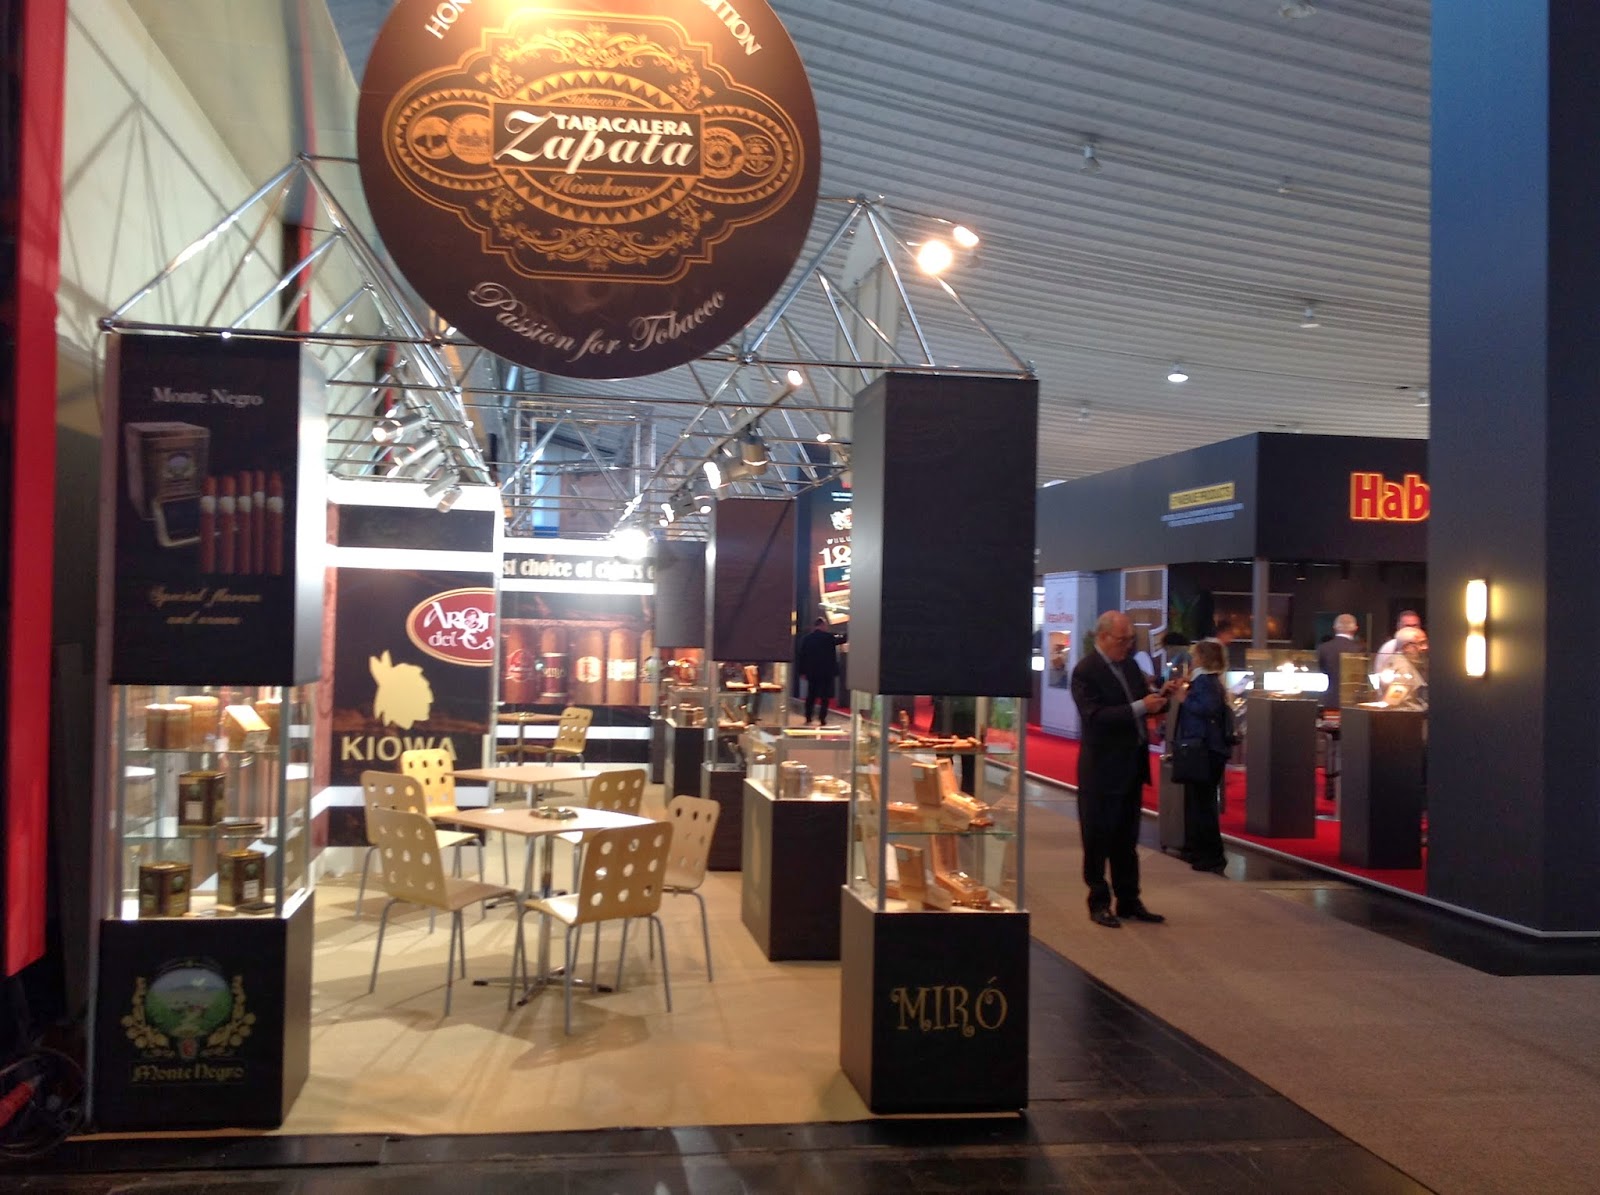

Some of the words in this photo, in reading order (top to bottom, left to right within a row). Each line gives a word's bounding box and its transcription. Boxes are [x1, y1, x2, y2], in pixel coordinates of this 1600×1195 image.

[493, 109, 699, 175] Zapata
[552, 113, 694, 137] TABACALERA
[467, 281, 576, 352] Passion
[565, 328, 622, 364] for
[628, 289, 727, 352] Tobacco
[520, 558, 573, 577] choice
[890, 976, 1009, 1037] MIRÓ
